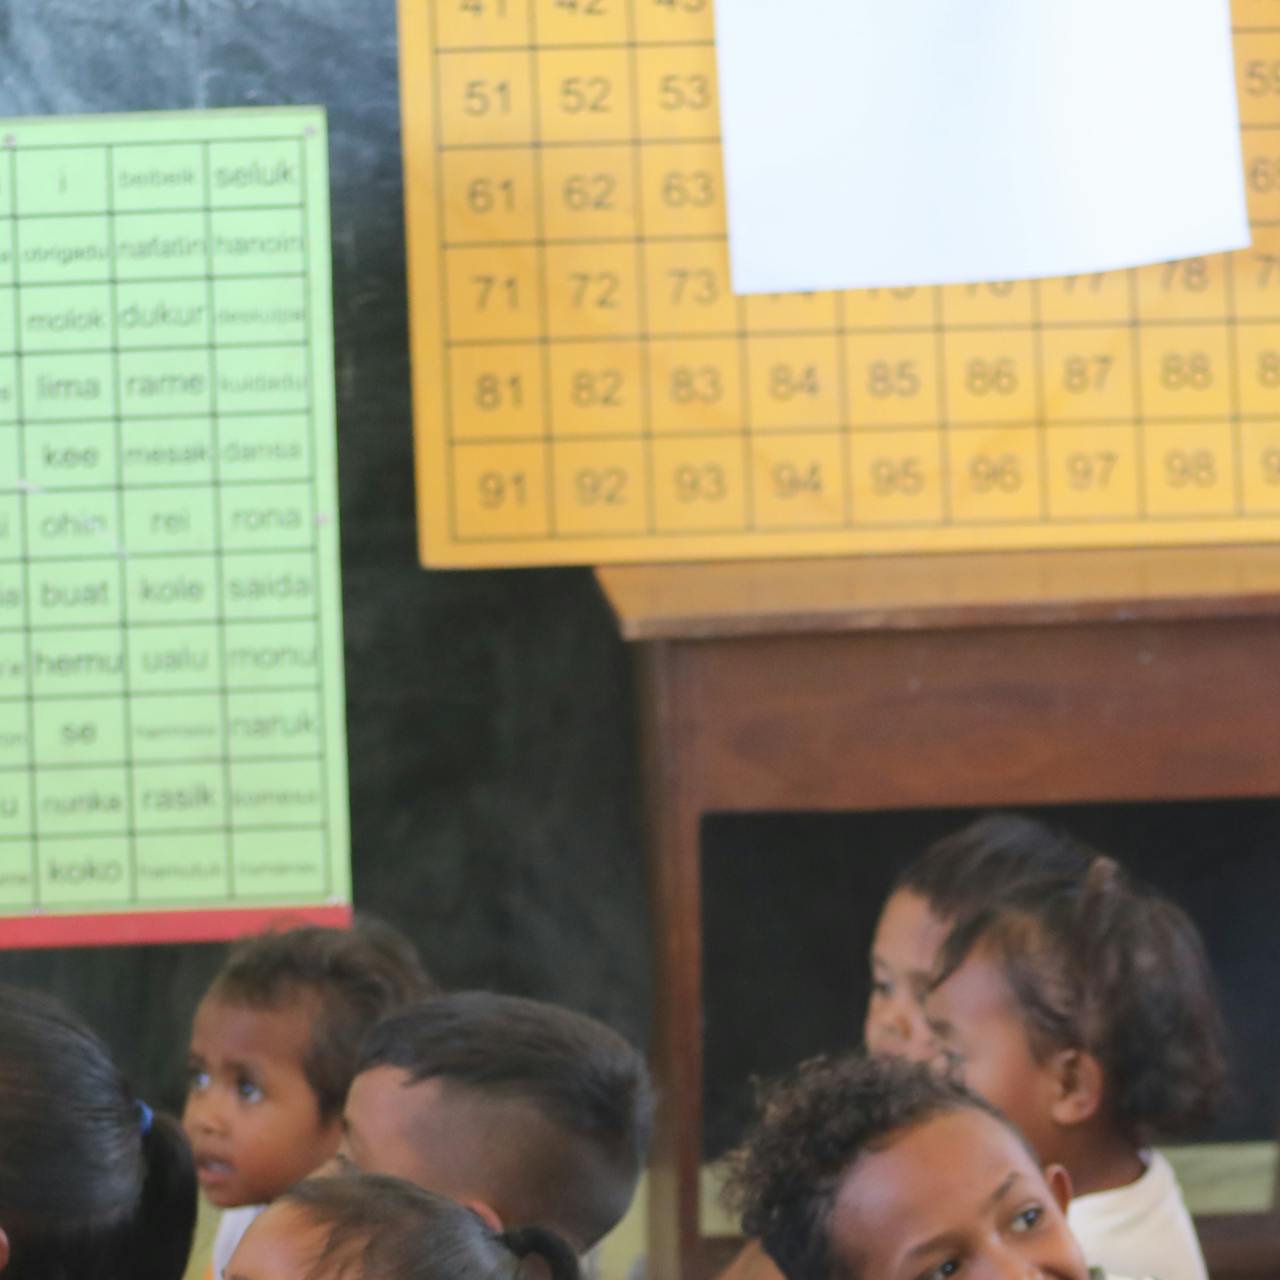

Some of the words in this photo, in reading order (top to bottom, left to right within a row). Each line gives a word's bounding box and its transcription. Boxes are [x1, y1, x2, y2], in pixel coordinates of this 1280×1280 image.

[465, 80, 509, 116] 51
[560, 76, 610, 113] 52
[658, 74, 712, 111] 53
[466, 177, 514, 213] 61
[562, 173, 615, 211] 62
[661, 169, 716, 208] 63
[472, 275, 518, 310] 71
[568, 270, 619, 308] 72
[666, 267, 718, 309] 73
[1158, 258, 1211, 294] 78
[37, 375, 102, 399] lima
[126, 373, 204, 397] rame
[474, 372, 522, 410] 81
[570, 368, 623, 407] 82
[669, 365, 722, 405] 83
[769, 363, 818, 402] 84
[866, 359, 920, 399] 85
[964, 357, 1018, 396] 86
[1062, 353, 1115, 394] 87
[1159, 352, 1212, 390] 88
[42, 445, 99, 468] kee
[478, 471, 525, 509] 91
[573, 467, 627, 506] 92
[673, 463, 726, 503] 93
[769, 462, 822, 497] 94
[870, 456, 925, 496] 95
[968, 453, 1022, 493] 96
[1066, 450, 1118, 490] 97
[1163, 449, 1216, 488] 98
[150, 509, 190, 534] rei
[231, 507, 302, 531] rona
[40, 580, 110, 608] buat
[138, 574, 204, 603] kole
[141, 645, 209, 673] ualu
[48, 857, 121, 884] koko
